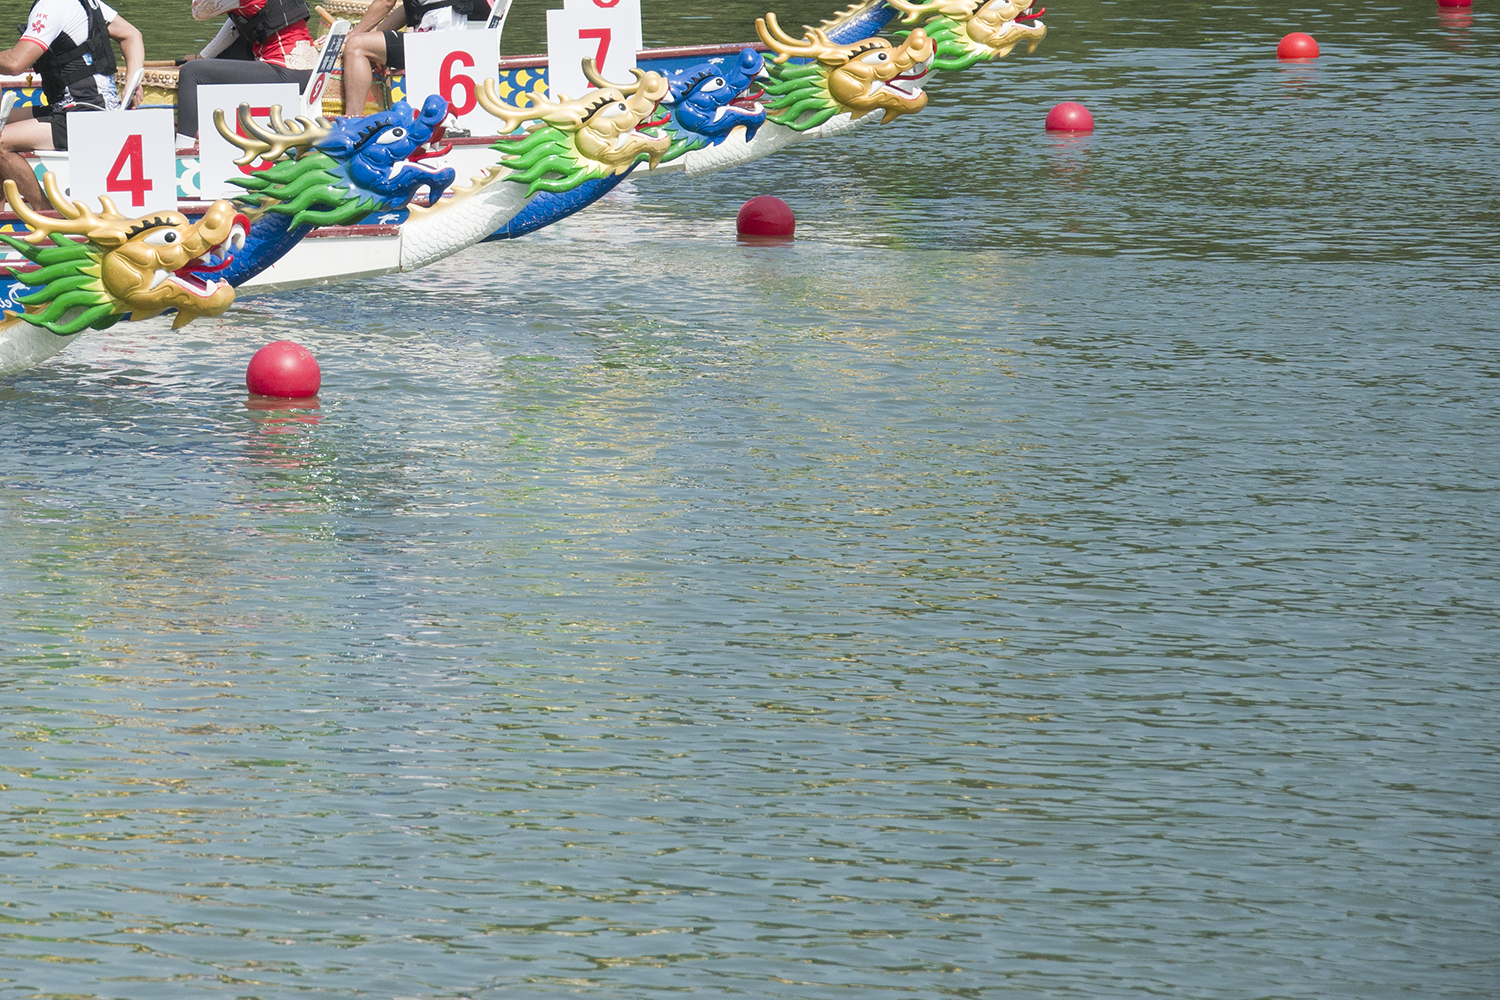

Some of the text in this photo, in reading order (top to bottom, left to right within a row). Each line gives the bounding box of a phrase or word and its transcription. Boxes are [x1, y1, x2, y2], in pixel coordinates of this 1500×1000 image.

[313, 80, 322, 97] 9
[439, 50, 477, 116] 6
[579, 28, 611, 88] 7
[106, 134, 153, 207] 4
